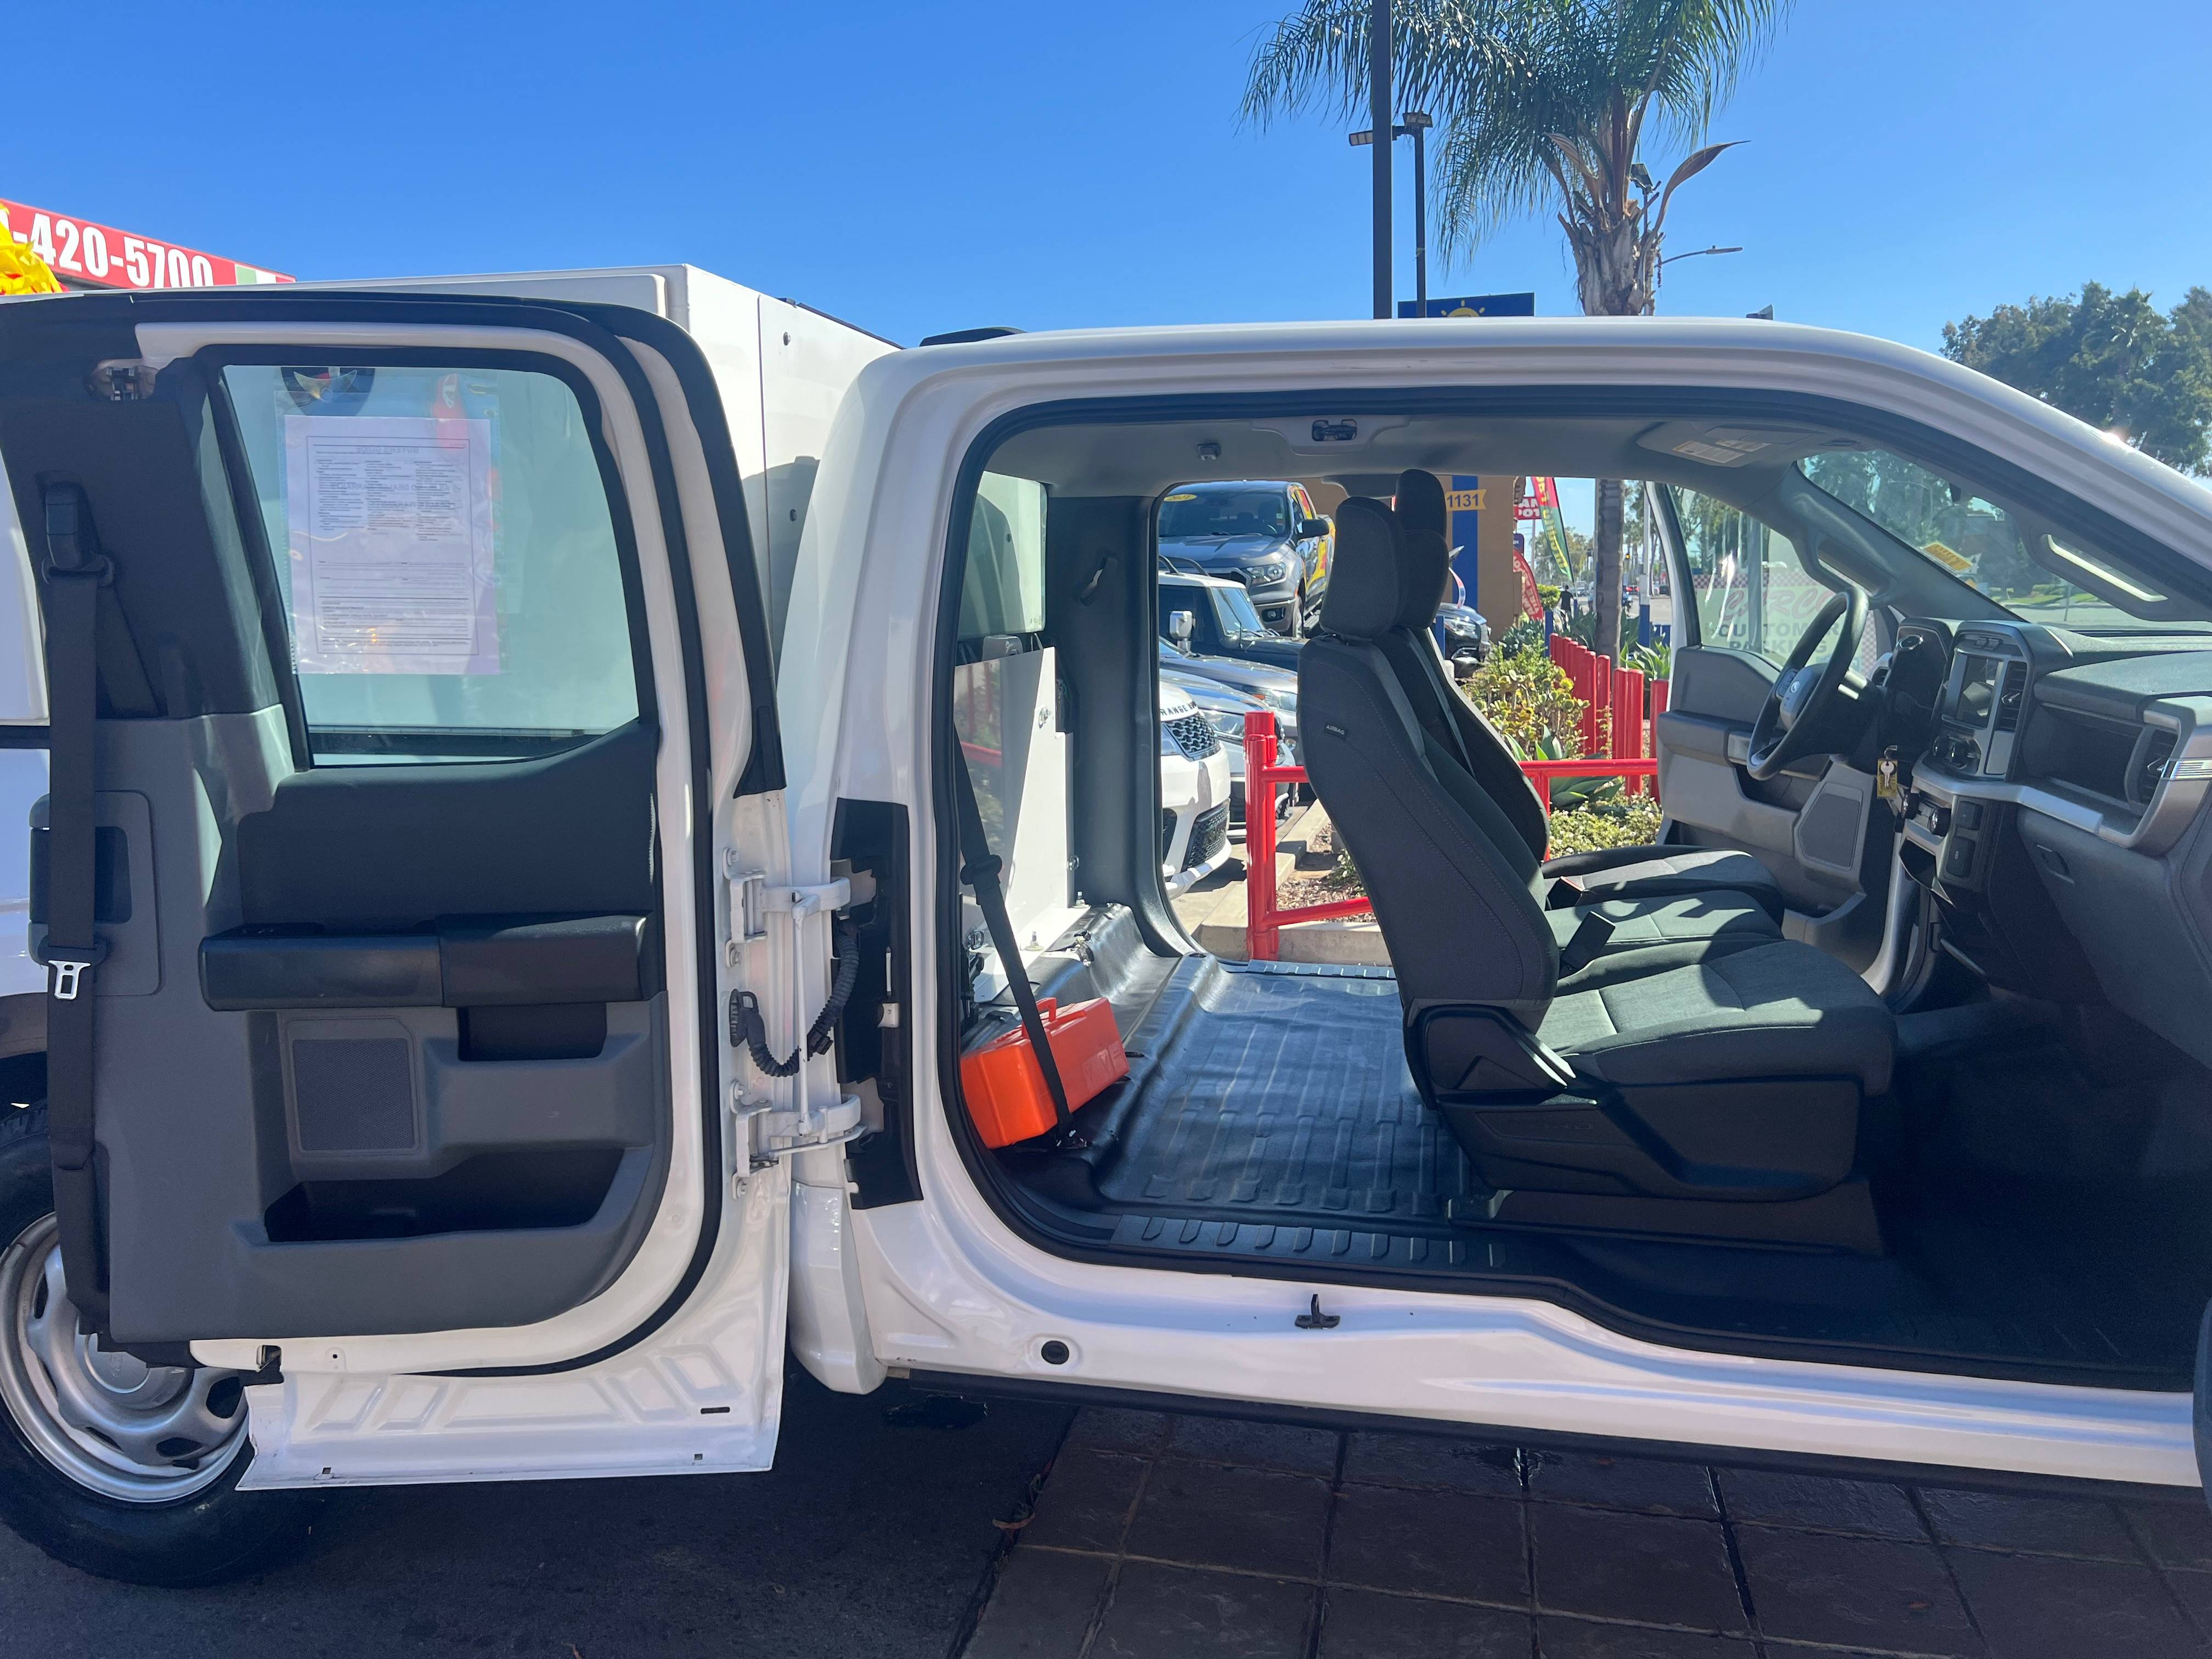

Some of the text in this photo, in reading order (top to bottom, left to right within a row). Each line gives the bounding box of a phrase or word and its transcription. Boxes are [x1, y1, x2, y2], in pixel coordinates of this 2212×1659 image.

[0, 210, 214, 289] -420-5700
[1446, 494, 1479, 508] 1131
[1718, 622, 1839, 637] CUTOMR
[1159, 704, 1189, 716] RANGE
[1325, 724, 1345, 736] AIRBAG
